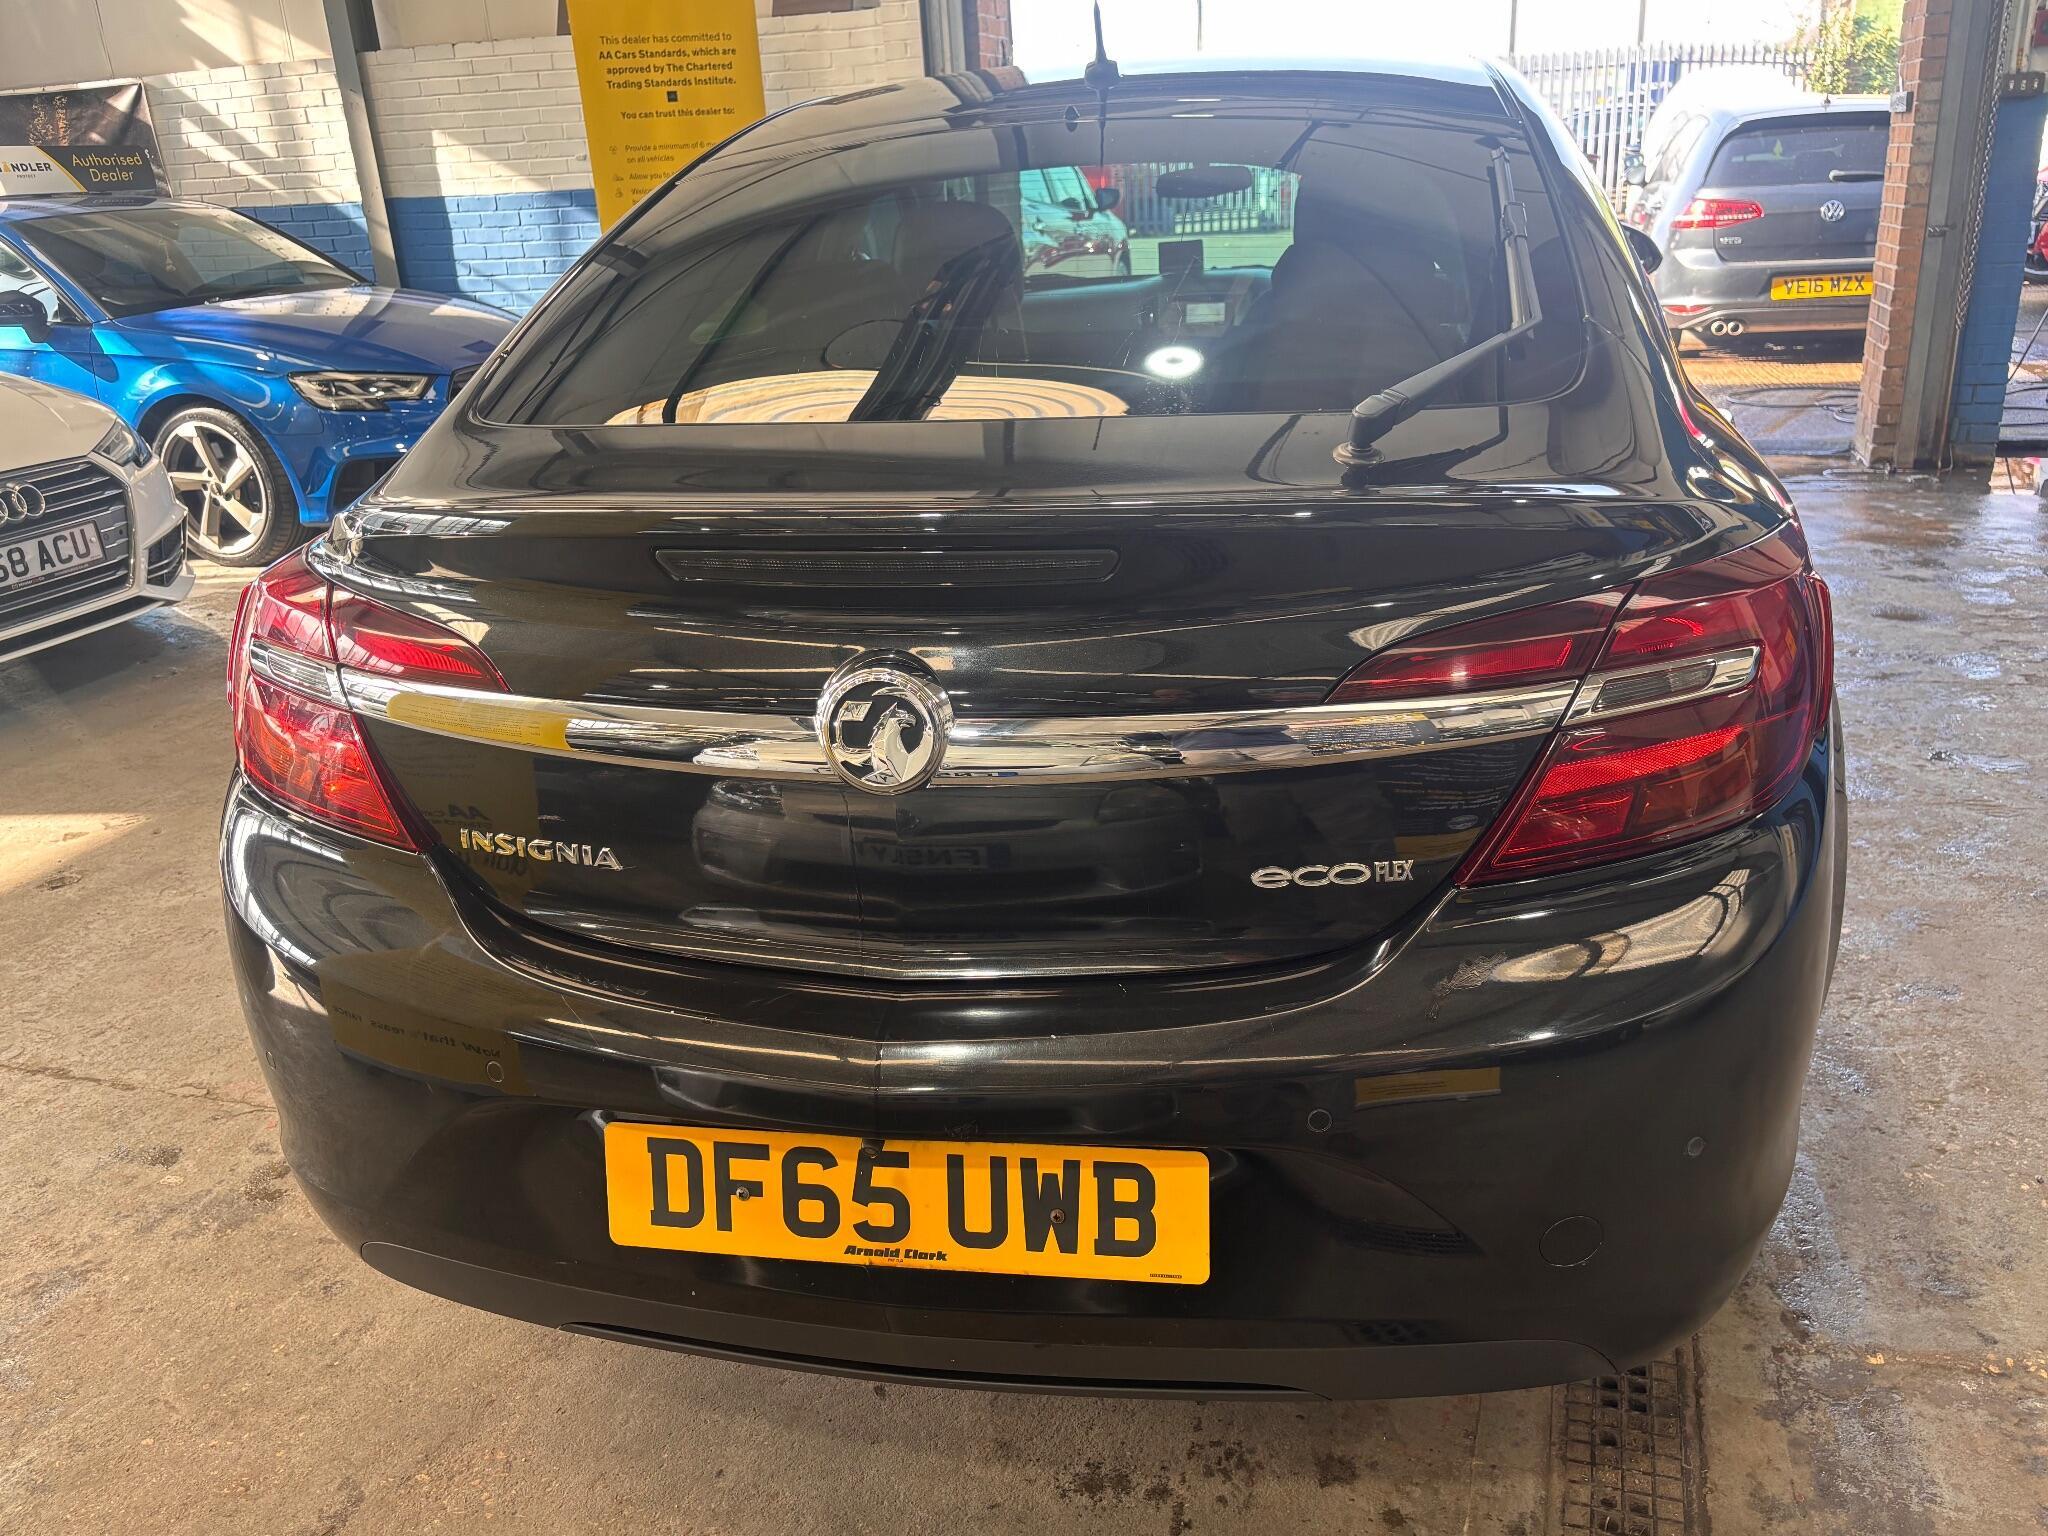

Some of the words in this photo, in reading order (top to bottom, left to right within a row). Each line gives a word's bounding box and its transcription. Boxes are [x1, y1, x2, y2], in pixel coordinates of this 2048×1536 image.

[600, 35, 619, 45] This
[622, 34, 650, 45] dealer
[653, 34, 669, 43] has
[671, 32, 720, 42] committed
[722, 32, 732, 41] to
[599, 51, 613, 60] AA
[615, 50, 637, 60] Cars
[639, 48, 690, 59] Standards,
[692, 47, 720, 57] which
[722, 48, 737, 56] are
[606, 64, 651, 76] approved
[653, 64, 665, 74] by
[667, 63, 685, 73] The
[686, 61, 733, 72] Chartered
[606, 80, 642, 90] Trading
[644, 77, 693, 88] Standards
[695, 76, 737, 86] Institute.
[621, 111, 637, 120] You
[639, 111, 654, 119] can
[655, 109, 676, 119] trust
[678, 108, 693, 117] this
[695, 107, 721, 117] dealer
[625, 144, 651, 152] Provide
[658, 143, 691, 151] minimum
[72, 153, 142, 167] Authorised
[646, 155, 675, 163] vehicles
[89, 169, 134, 182] Dealer
[1831, 274, 1865, 292] MZX
[37, 528, 91, 571] ACU
[460, 828, 623, 871] INSIGNIA
[647, 1137, 911, 1244] DF65
[947, 1153, 1157, 1258] UWB
[844, 1245, 900, 1258] Arnold
[904, 1249, 947, 1261] Clark
